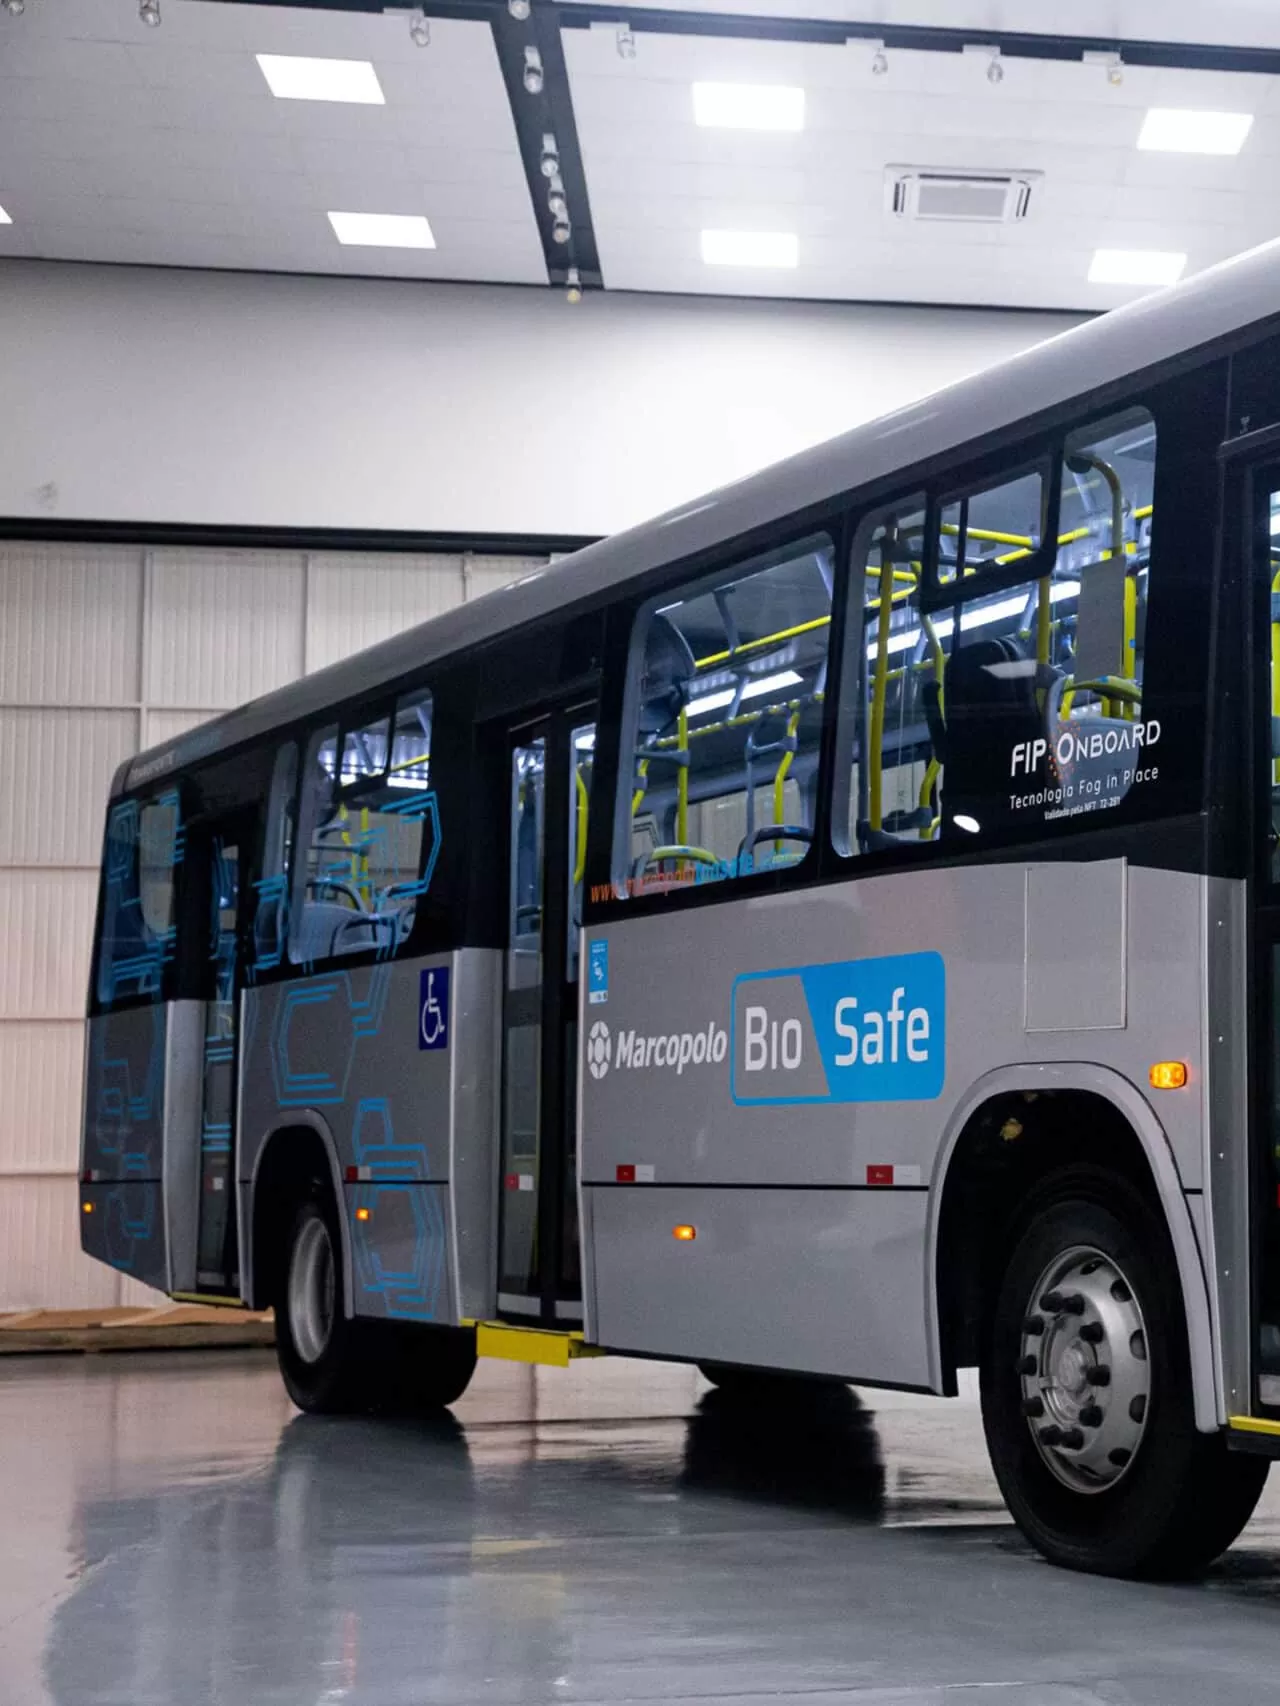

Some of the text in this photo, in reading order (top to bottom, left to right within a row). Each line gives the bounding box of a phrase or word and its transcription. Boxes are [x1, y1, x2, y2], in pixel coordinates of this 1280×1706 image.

[1010, 719, 1161, 777] FIP ONBOARD
[1009, 787, 1074, 810] Tecnologia
[1079, 780, 1101, 795] Fog
[1123, 765, 1159, 784] Place
[615, 1022, 728, 1076] Marcopolo
[744, 987, 930, 1072] Bio Safe
